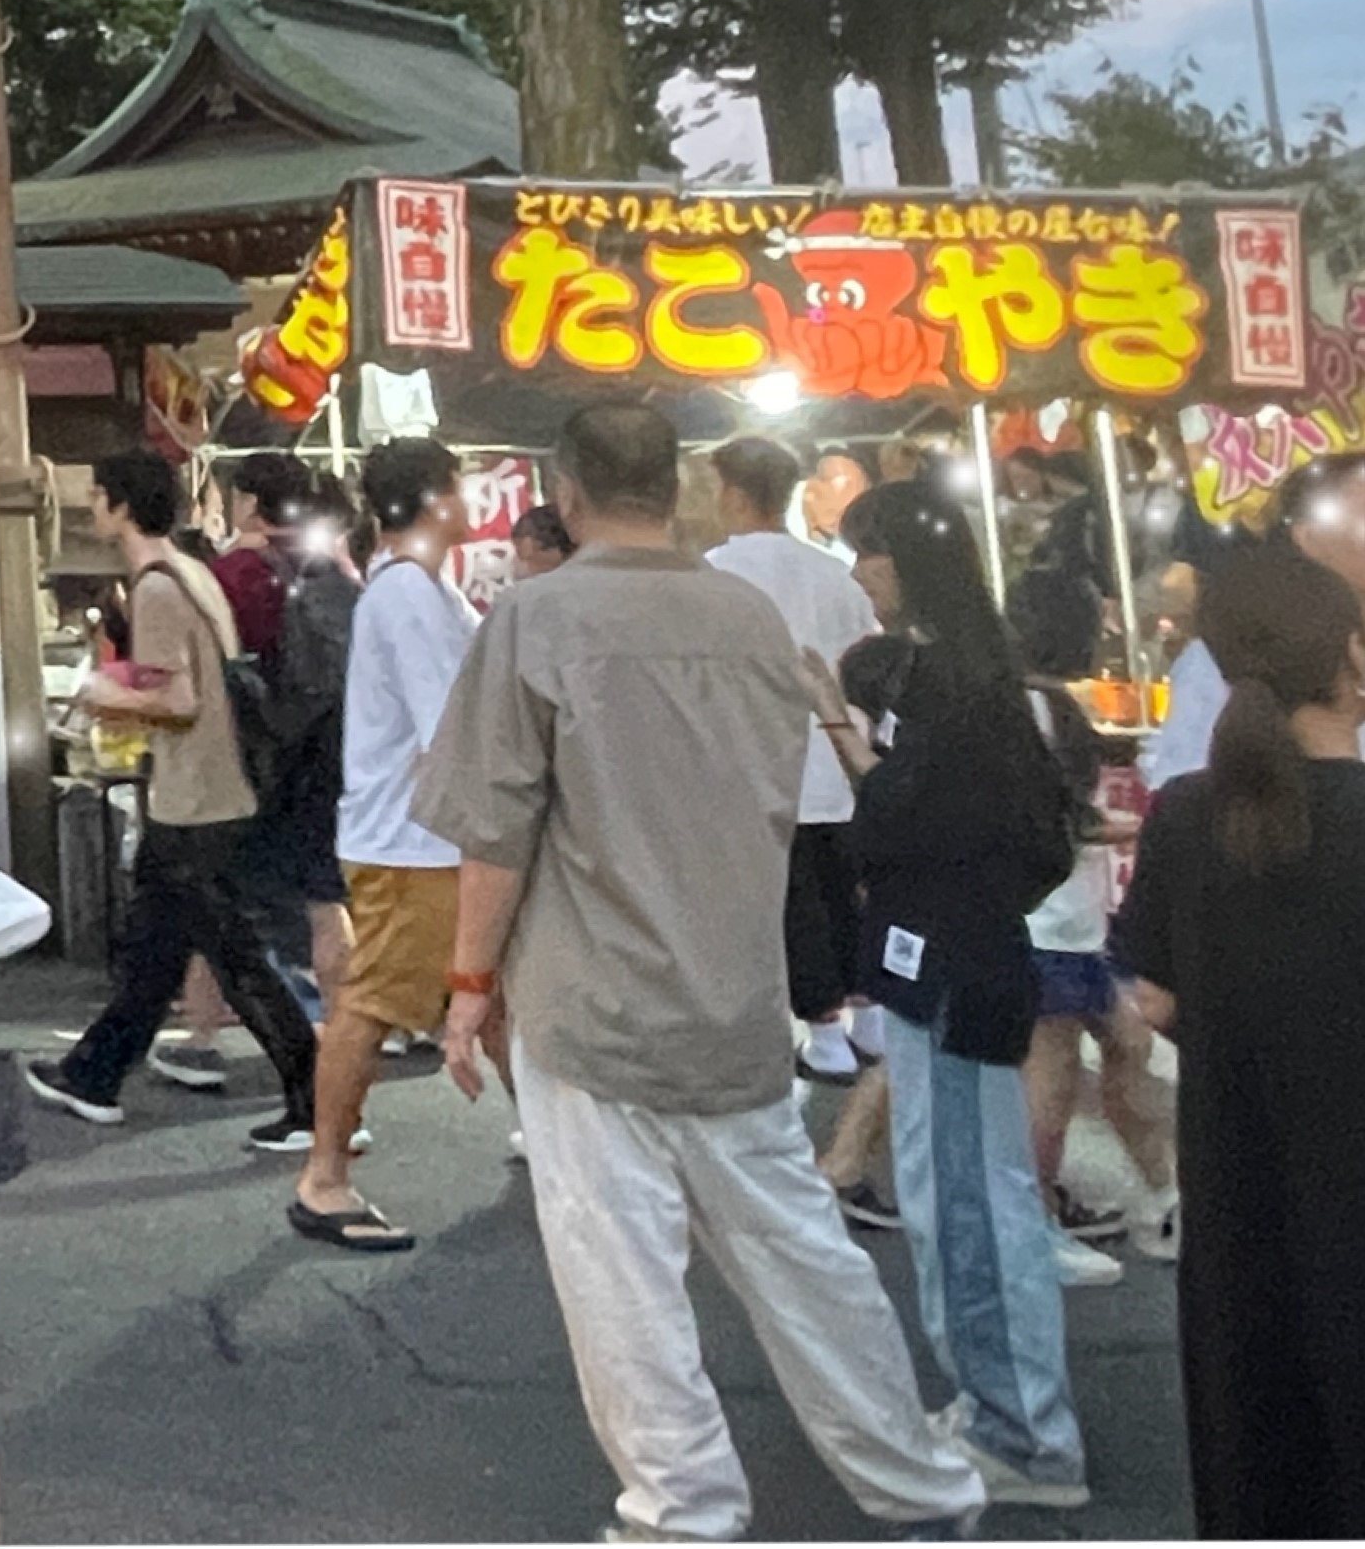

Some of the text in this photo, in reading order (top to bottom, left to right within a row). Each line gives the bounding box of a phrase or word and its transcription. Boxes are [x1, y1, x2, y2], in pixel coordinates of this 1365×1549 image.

[395, 195, 451, 331] 味自慢
[492, 226, 769, 376] たこ
[919, 240, 1208, 394] やき
[1234, 228, 1292, 366] 味自慢
